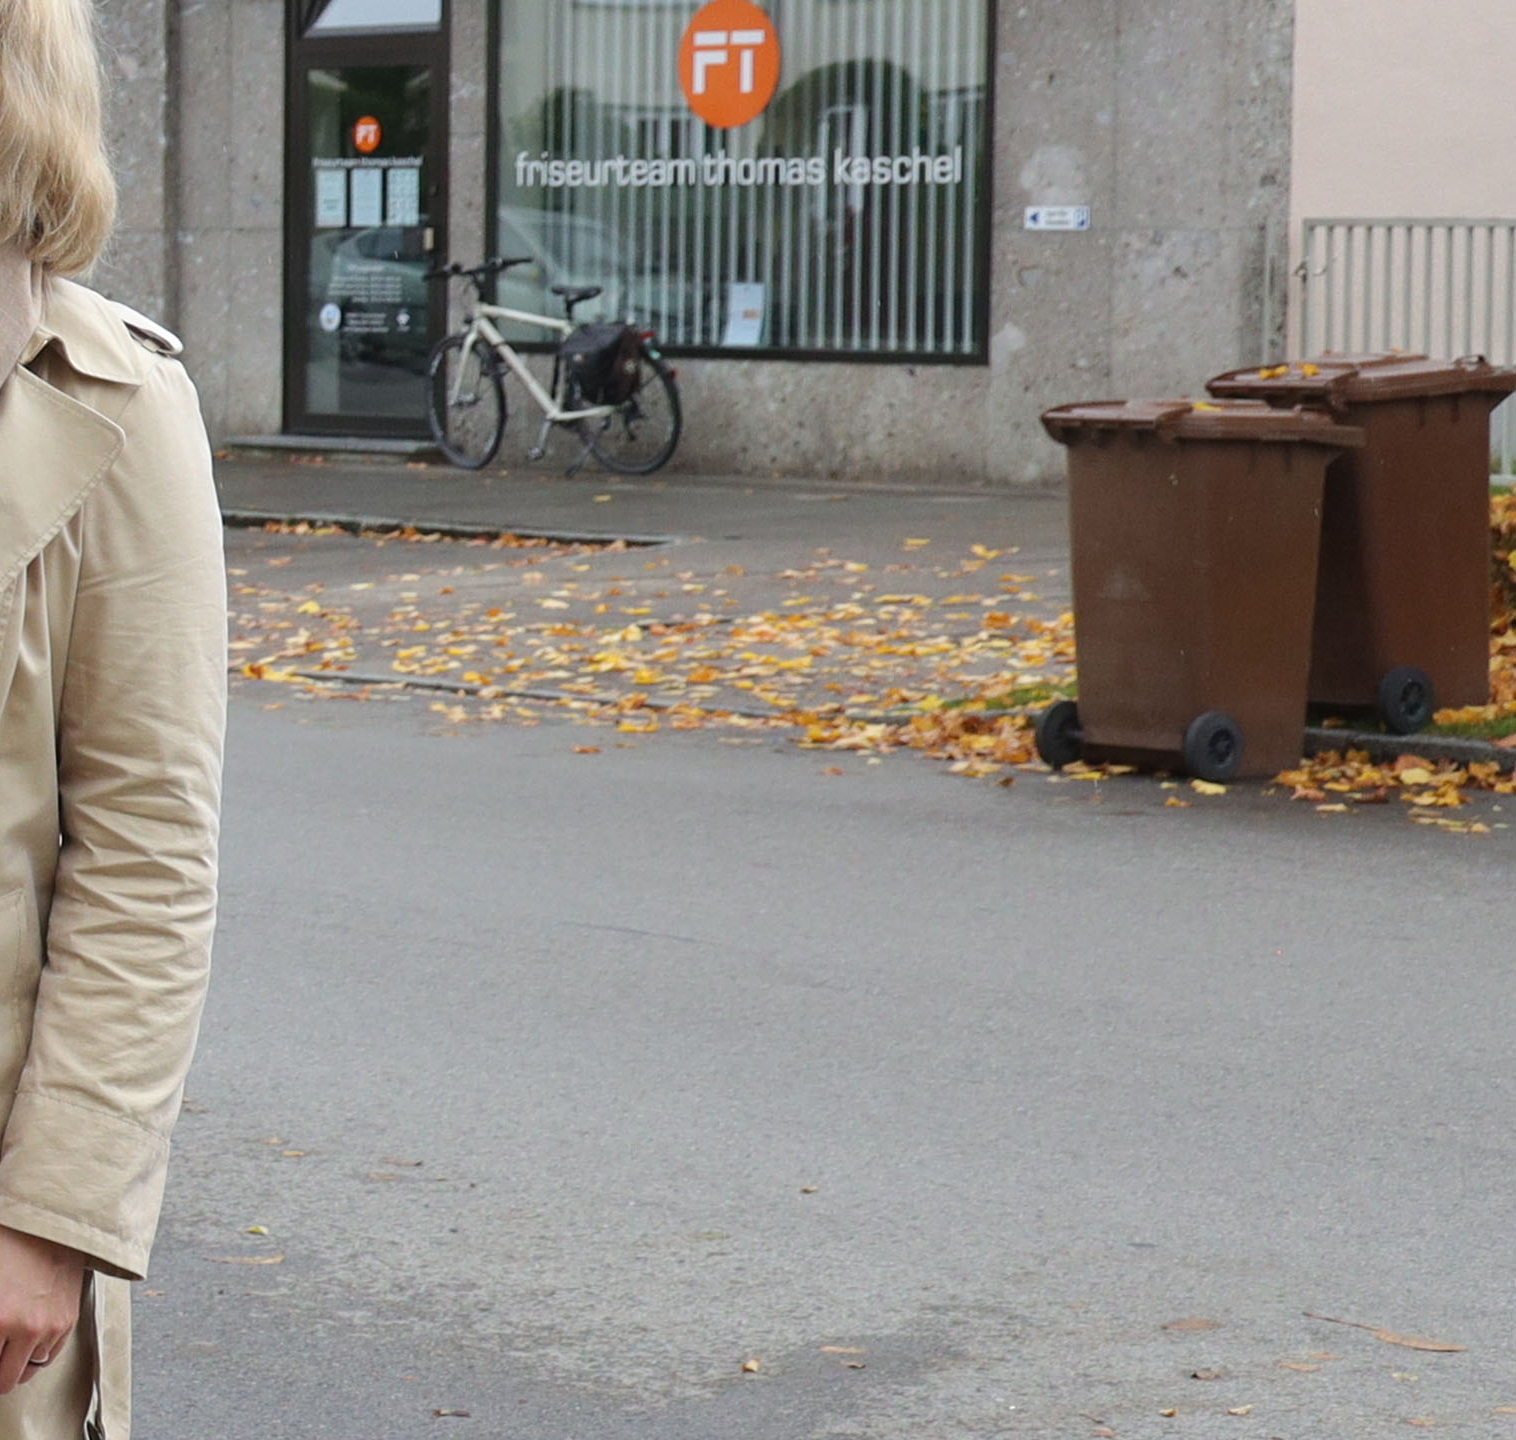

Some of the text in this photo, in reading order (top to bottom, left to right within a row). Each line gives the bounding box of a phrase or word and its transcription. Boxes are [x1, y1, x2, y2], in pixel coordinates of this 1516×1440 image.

[692, 29, 765, 95] FT
[515, 146, 962, 189] friseurteam thomas kaschel
